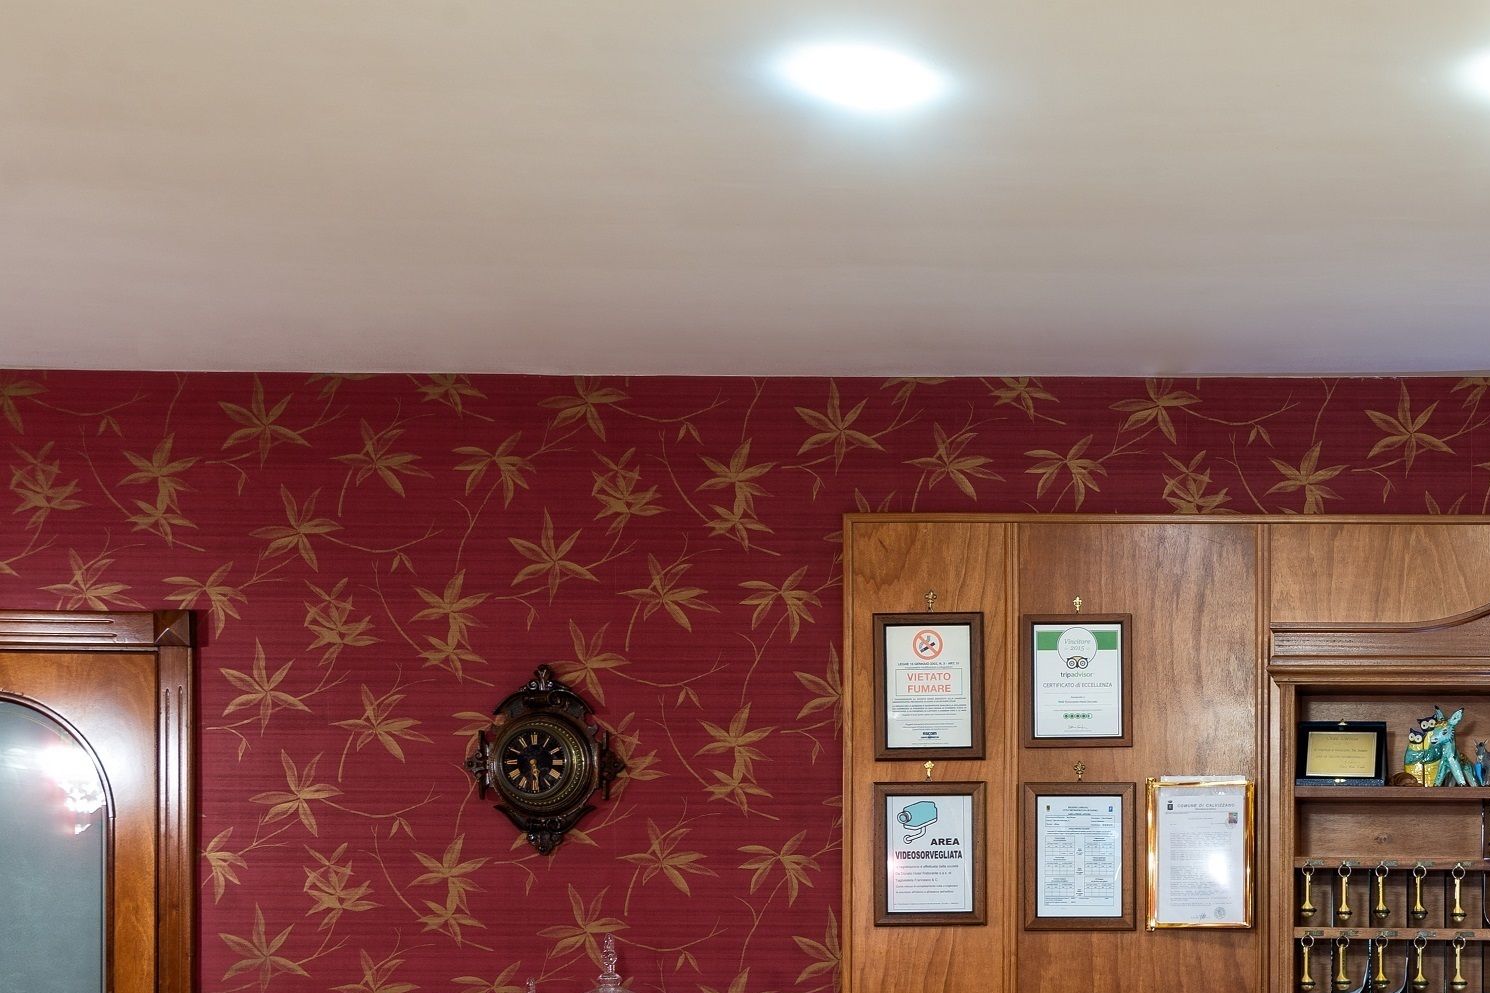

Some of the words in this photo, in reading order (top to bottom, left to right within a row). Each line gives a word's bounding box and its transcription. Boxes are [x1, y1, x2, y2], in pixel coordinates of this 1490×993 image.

[907, 672, 951, 681] VIETATO
[907, 684, 951, 693] FUMARE
[895, 850, 963, 859] VIDEOSORVEGLIATA
